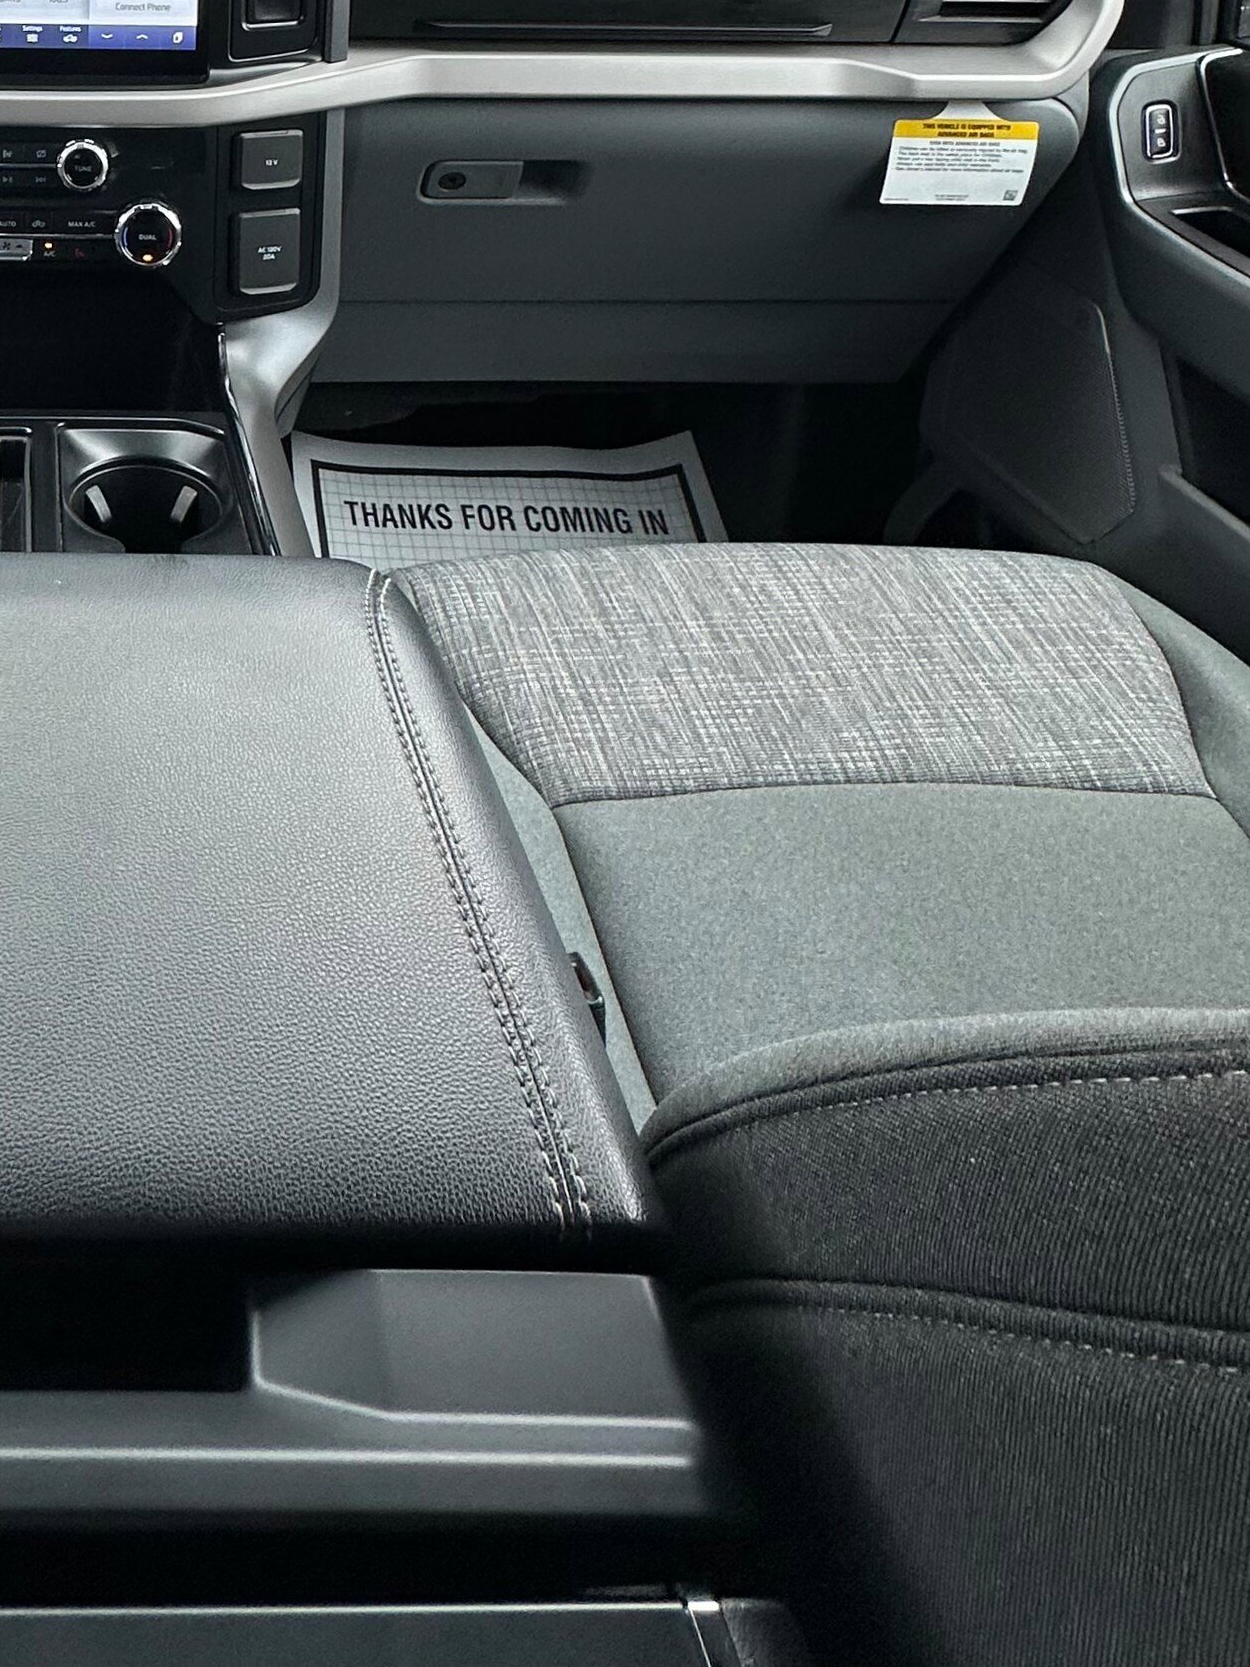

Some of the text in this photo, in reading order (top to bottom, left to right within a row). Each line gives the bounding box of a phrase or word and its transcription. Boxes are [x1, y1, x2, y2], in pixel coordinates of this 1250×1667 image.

[115, 2, 171, 11] Connect Phone
[68, 220, 97, 228] MAX A/C
[344, 500, 670, 536] THANKS FOR COMING IN
